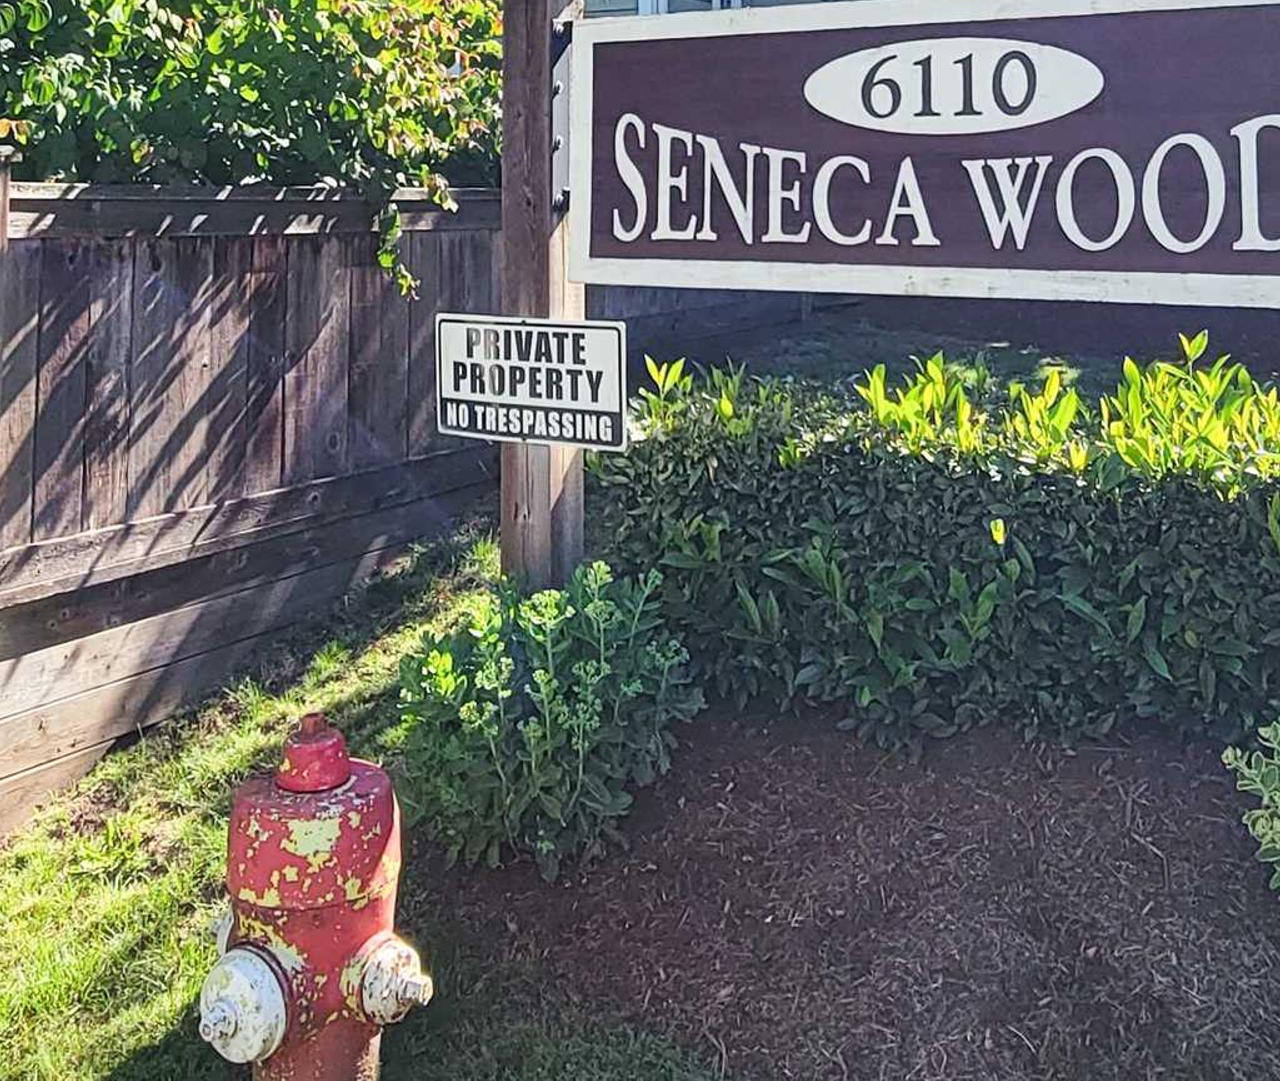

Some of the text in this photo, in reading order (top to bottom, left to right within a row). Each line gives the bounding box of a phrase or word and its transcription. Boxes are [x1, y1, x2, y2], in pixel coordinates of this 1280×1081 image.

[861, 48, 1038, 120] 6110
[612, 112, 940, 247] SENECA
[466, 327, 586, 365] PRIVATE
[453, 361, 604, 403] PROPERTY
[446, 402, 613, 442] NO TRESPASSING
